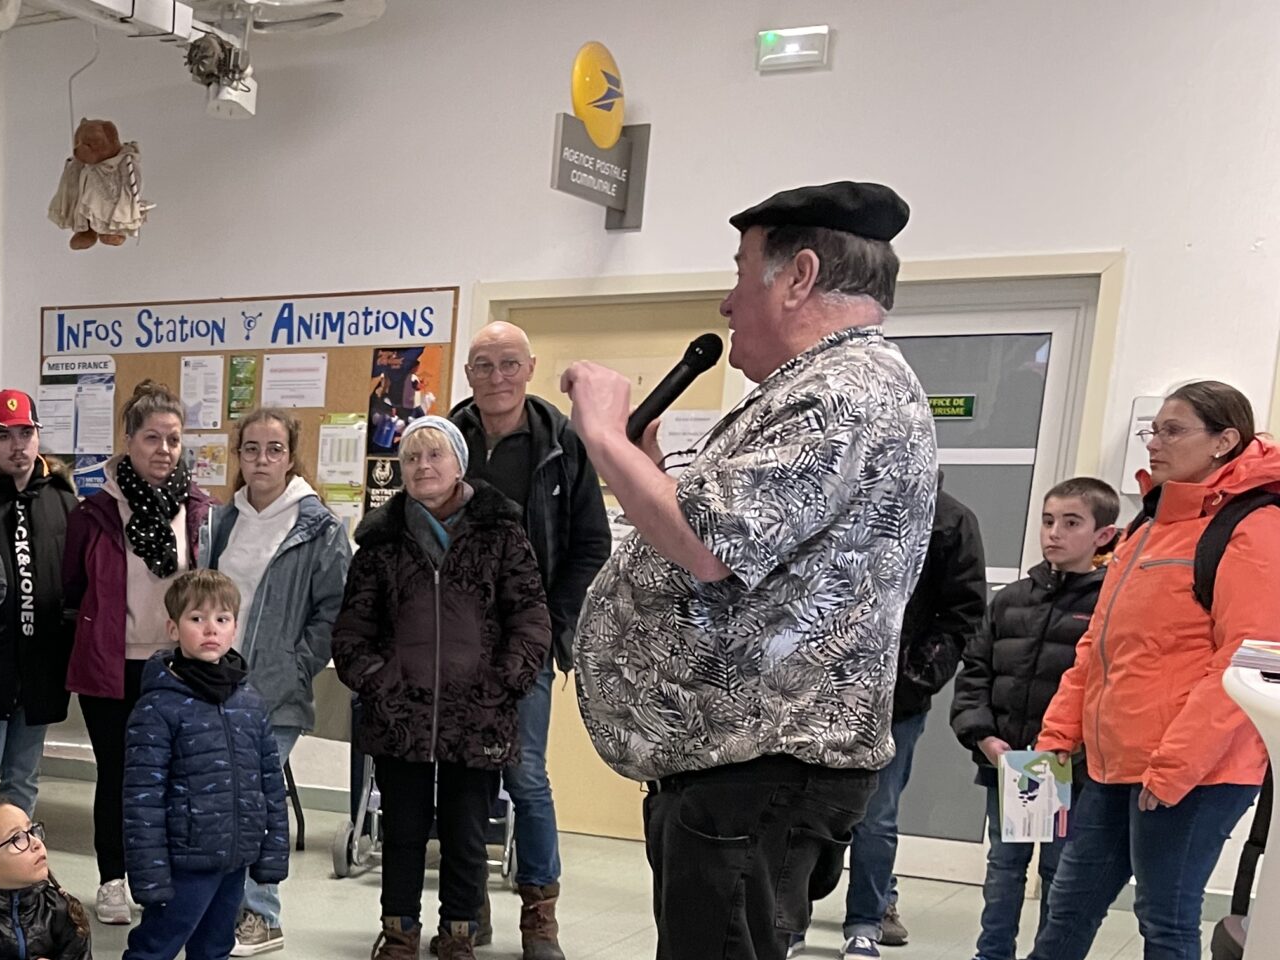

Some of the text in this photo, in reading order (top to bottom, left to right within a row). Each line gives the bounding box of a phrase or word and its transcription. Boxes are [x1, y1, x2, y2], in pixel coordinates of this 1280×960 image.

[563, 147, 628, 181] AGENCE POSTALE
[571, 170, 617, 196] COMMUNALE
[47, 361, 109, 371] METEO FRANCE
[952, 398, 965, 406] DE
